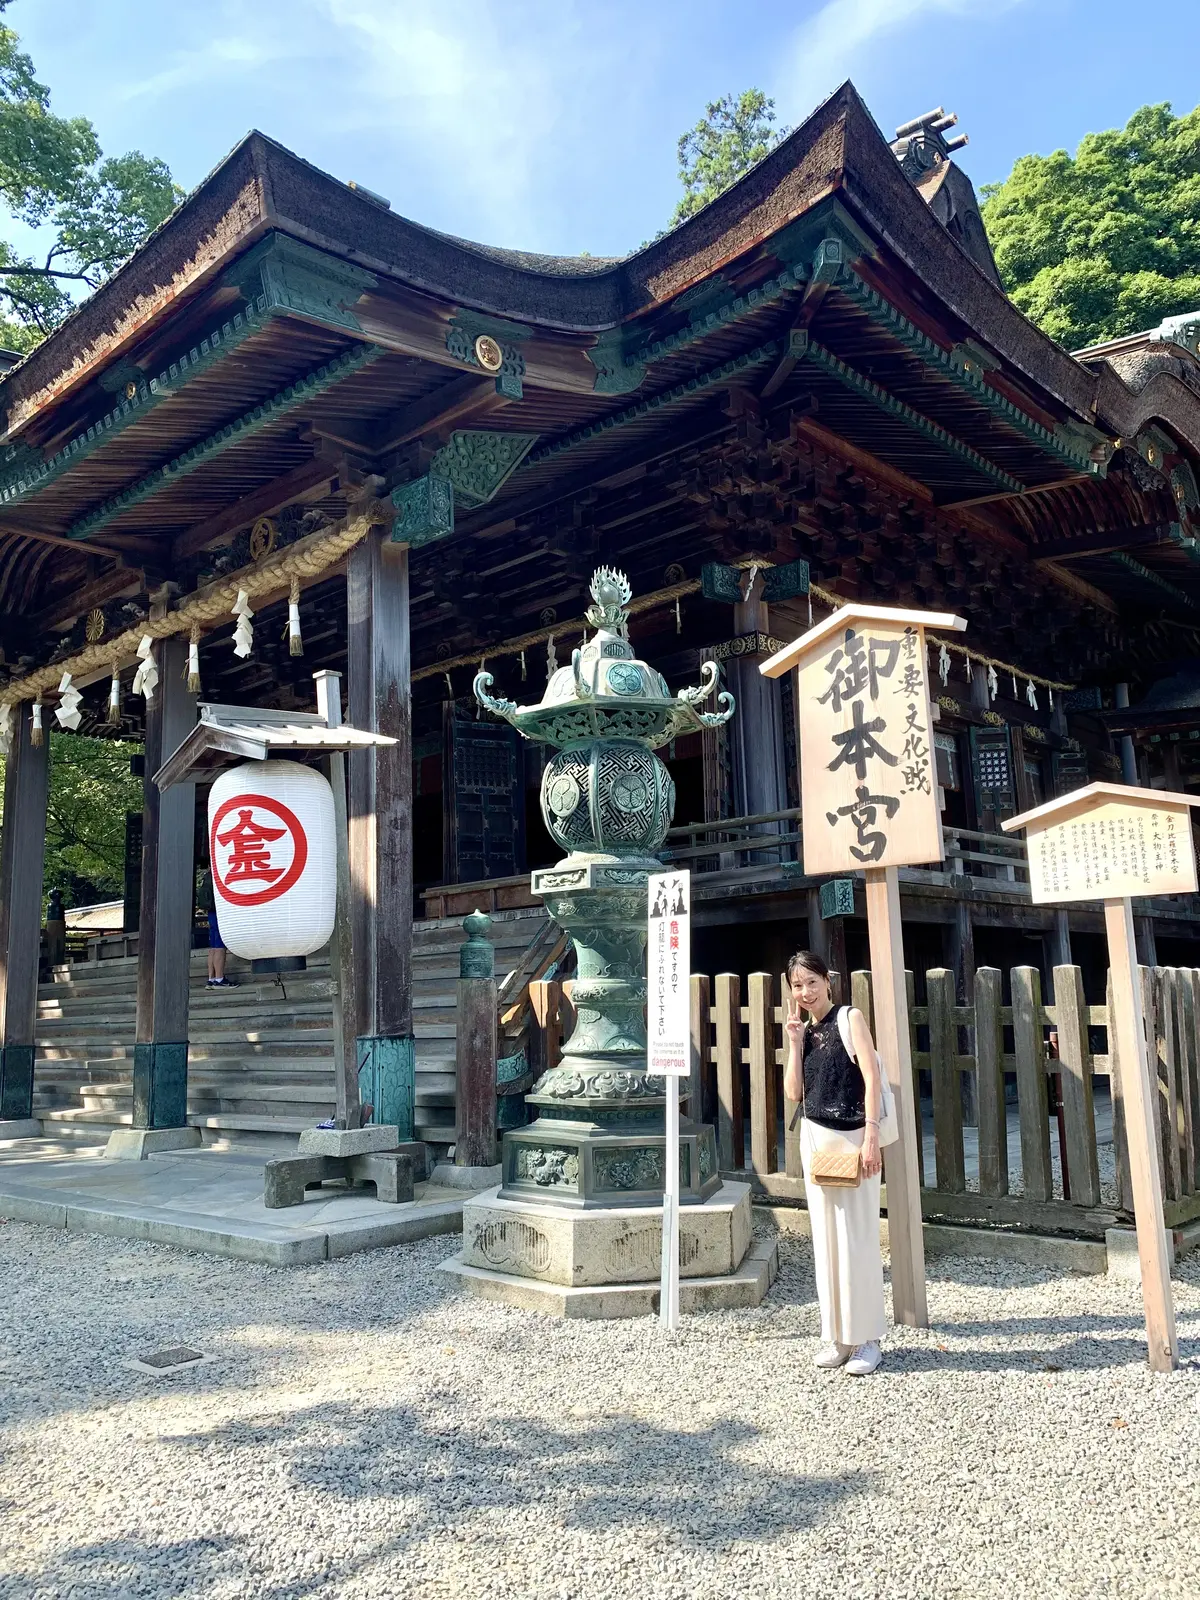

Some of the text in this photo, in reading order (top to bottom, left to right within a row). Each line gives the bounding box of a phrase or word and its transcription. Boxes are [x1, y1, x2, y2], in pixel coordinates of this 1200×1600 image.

[815, 629, 900, 862] 御本宮
[216, 810, 288, 886] 金
[652, 1056, 686, 1069] dangerous
